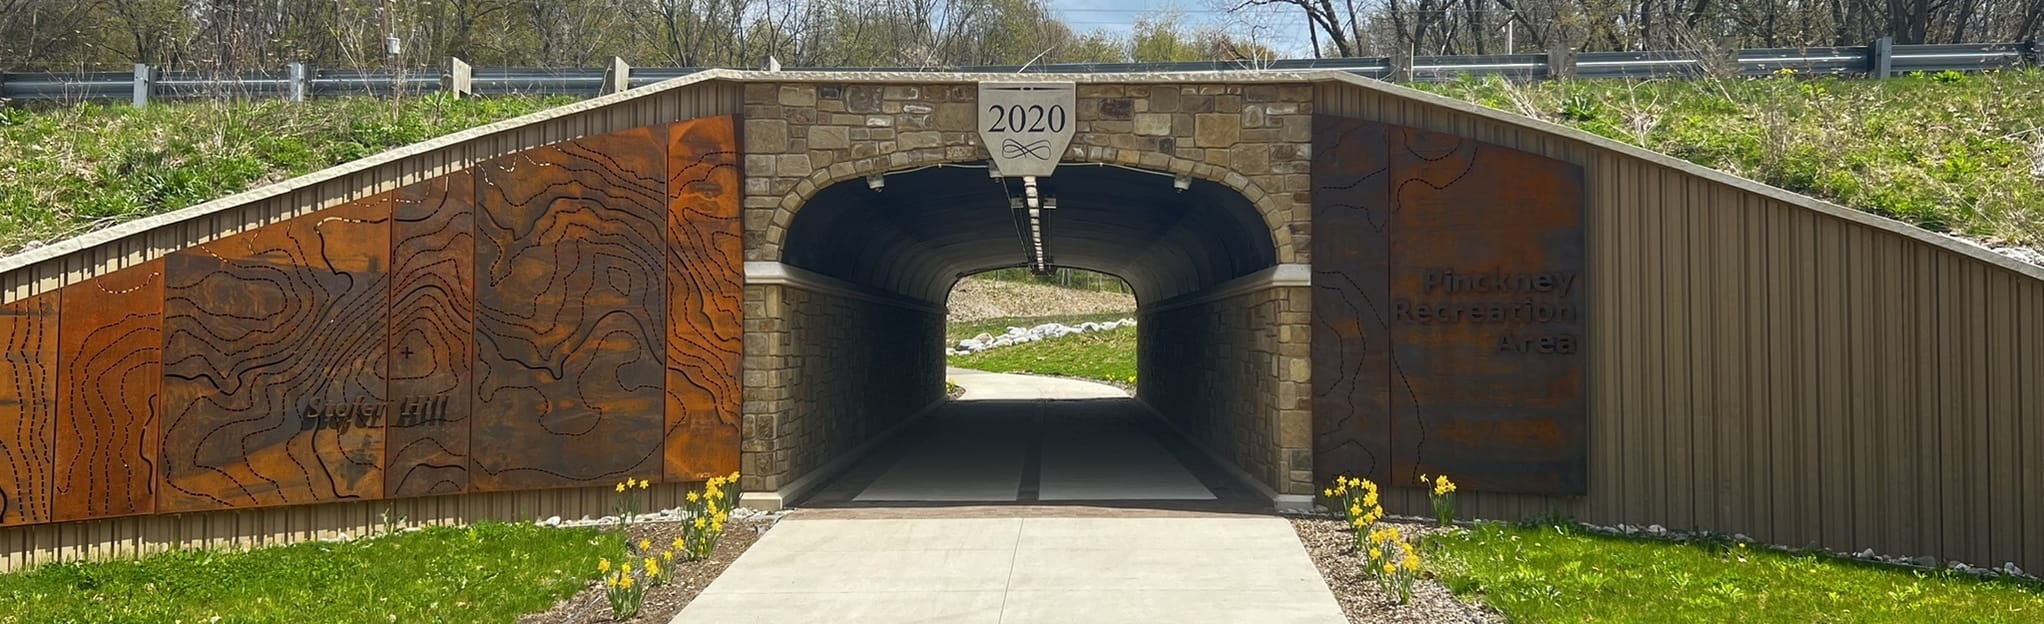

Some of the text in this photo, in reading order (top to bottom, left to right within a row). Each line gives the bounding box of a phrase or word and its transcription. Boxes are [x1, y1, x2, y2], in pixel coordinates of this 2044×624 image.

[988, 104, 1066, 133] 2020
[1422, 266, 1576, 298] Pinckney
[1395, 299, 1577, 324] Recreation
[1498, 330, 1577, 354] Area
[399, 395, 450, 424] Hill
